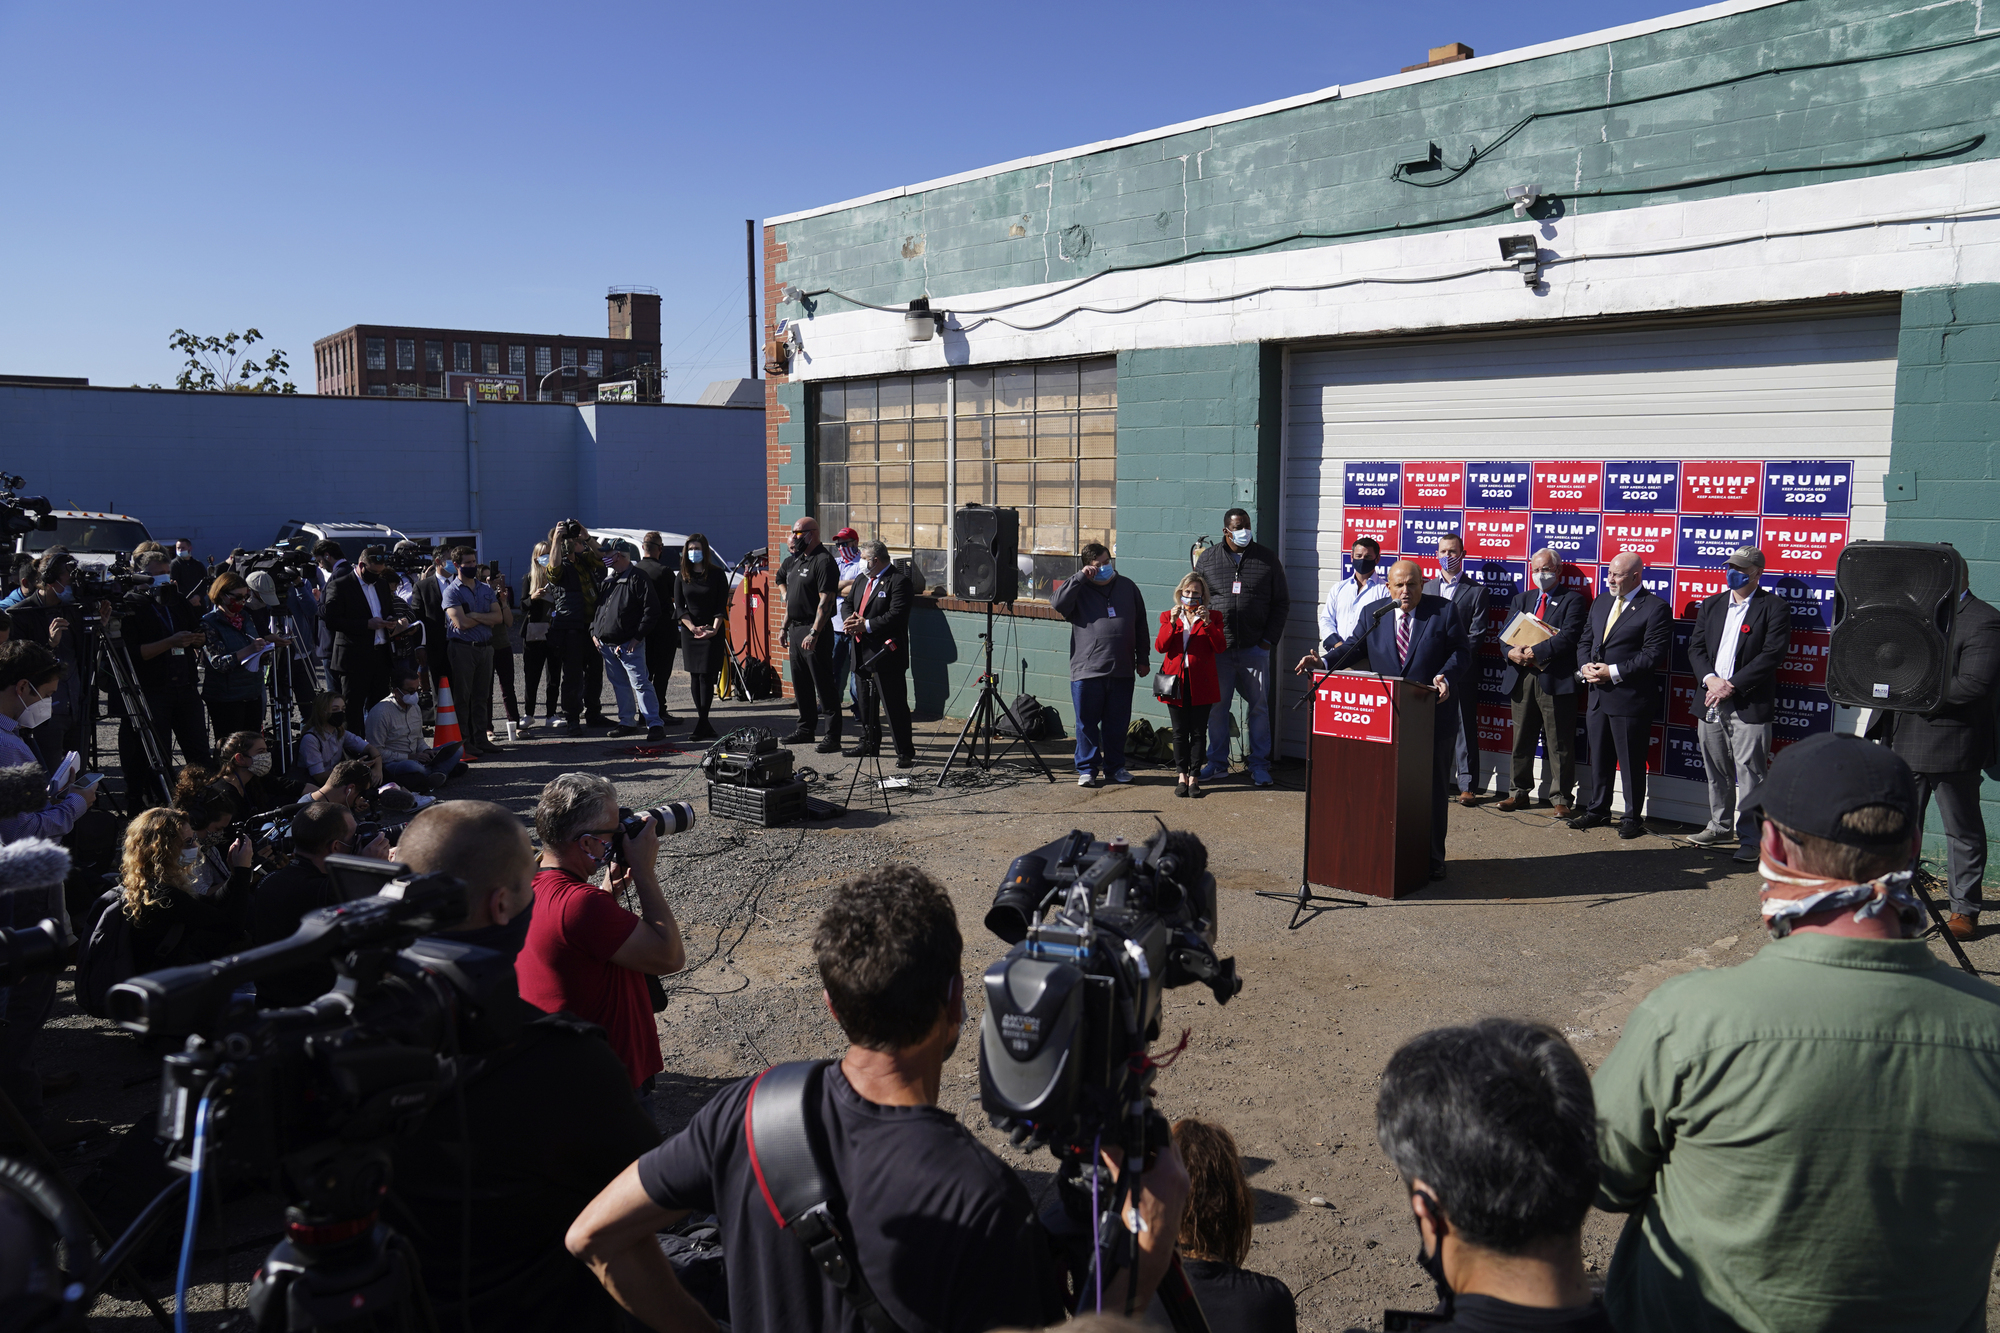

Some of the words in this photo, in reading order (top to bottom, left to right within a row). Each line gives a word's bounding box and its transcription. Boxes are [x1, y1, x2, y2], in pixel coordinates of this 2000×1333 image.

[479, 383, 520, 394] DEMND
[1347, 473, 1398, 482] TRUMP
[1406, 473, 1461, 483] TRUMP
[1469, 473, 1527, 483] TRUMP
[1536, 474, 1598, 484] TRUMP
[1608, 474, 1675, 484] TRUMP
[1687, 476, 1756, 486] TRUMP
[1769, 474, 1847, 486] TRUMP
[1358, 488, 1386, 496] 2020
[1418, 489, 1447, 497] 2020
[1481, 489, 1512, 498] 2020
[1549, 490, 1582, 499] 2020
[1622, 491, 1658, 500] 2020
[1785, 494, 1826, 503] 2020
[1346, 519, 1397, 529] TRUMP
[1405, 520, 1459, 530] TRUMP
[1467, 522, 1525, 533] TRUMP
[1534, 524, 1596, 535] TRUMP
[1606, 526, 1672, 537] TRUMP
[1682, 528, 1754, 540] TRUMP
[1765, 530, 1843, 543] TRUMP
[1479, 539, 1511, 547] 2020
[1547, 541, 1580, 550] 2020
[1619, 544, 1655, 553] 2020
[1697, 547, 1735, 555] 2020
[1781, 550, 1822, 560] 2020
[1465, 570, 1523, 582] TRUMP
[1560, 575, 1594, 586] UMP
[1603, 578, 1669, 590] TMP
[1679, 582, 1729, 593] TRU
[1488, 588, 1509, 596] 020
[1761, 586, 1835, 601] TRUMP
[1790, 606, 1818, 616] 020
[1787, 643, 1830, 657] UMP
[1318, 689, 1388, 707] TRUMP
[1774, 698, 1829, 713] RUMP
[1334, 711, 1371, 725] 2020
[1476, 716, 1514, 728] UMP
[1477, 731, 1502, 741] 020
